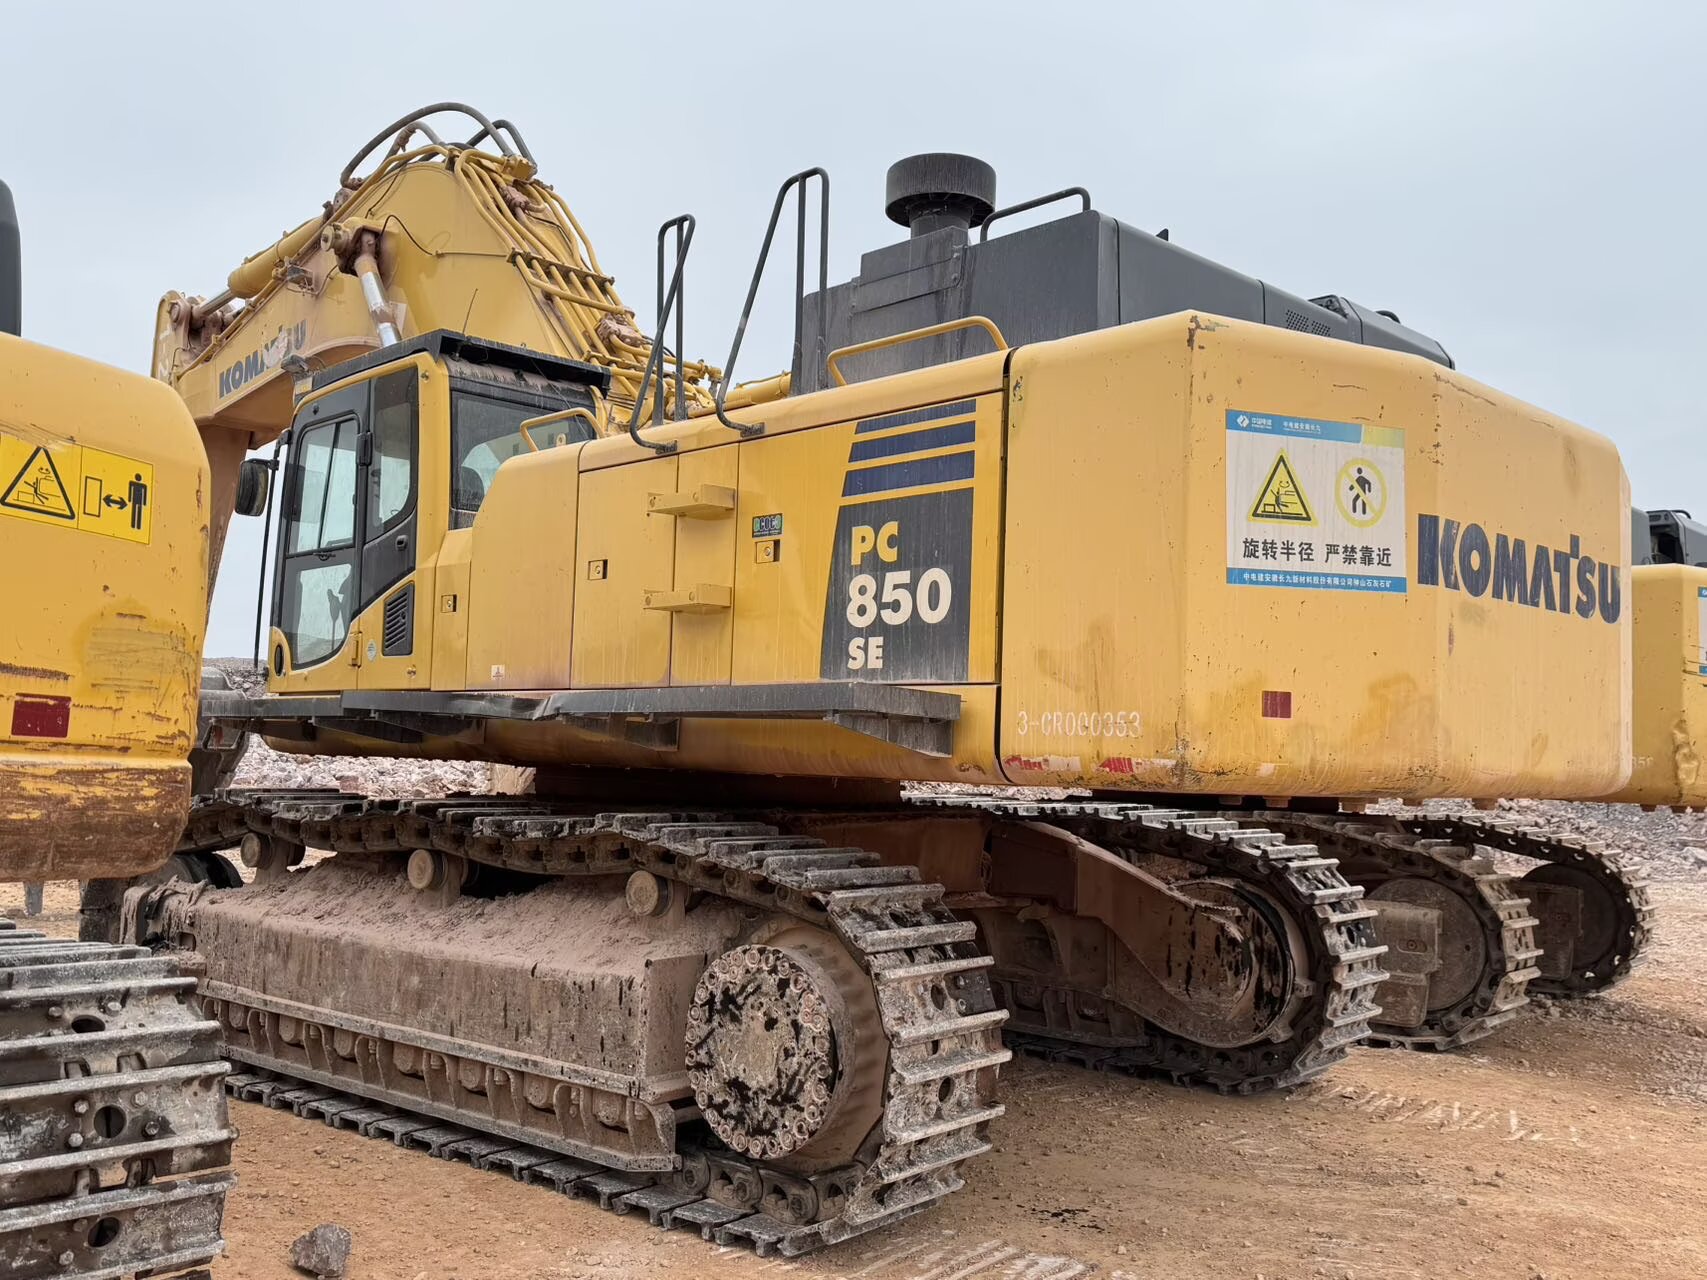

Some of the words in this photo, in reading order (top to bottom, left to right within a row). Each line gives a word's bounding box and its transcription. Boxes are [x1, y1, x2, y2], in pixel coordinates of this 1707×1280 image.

[851, 521, 898, 565] PC
[1242, 537, 1315, 562] 旋转半径
[1325, 543, 1392, 567] 严禁靠近
[1418, 513, 1620, 624] KOMATSU
[846, 567, 952, 628] 850
[847, 636, 884, 669] SE
